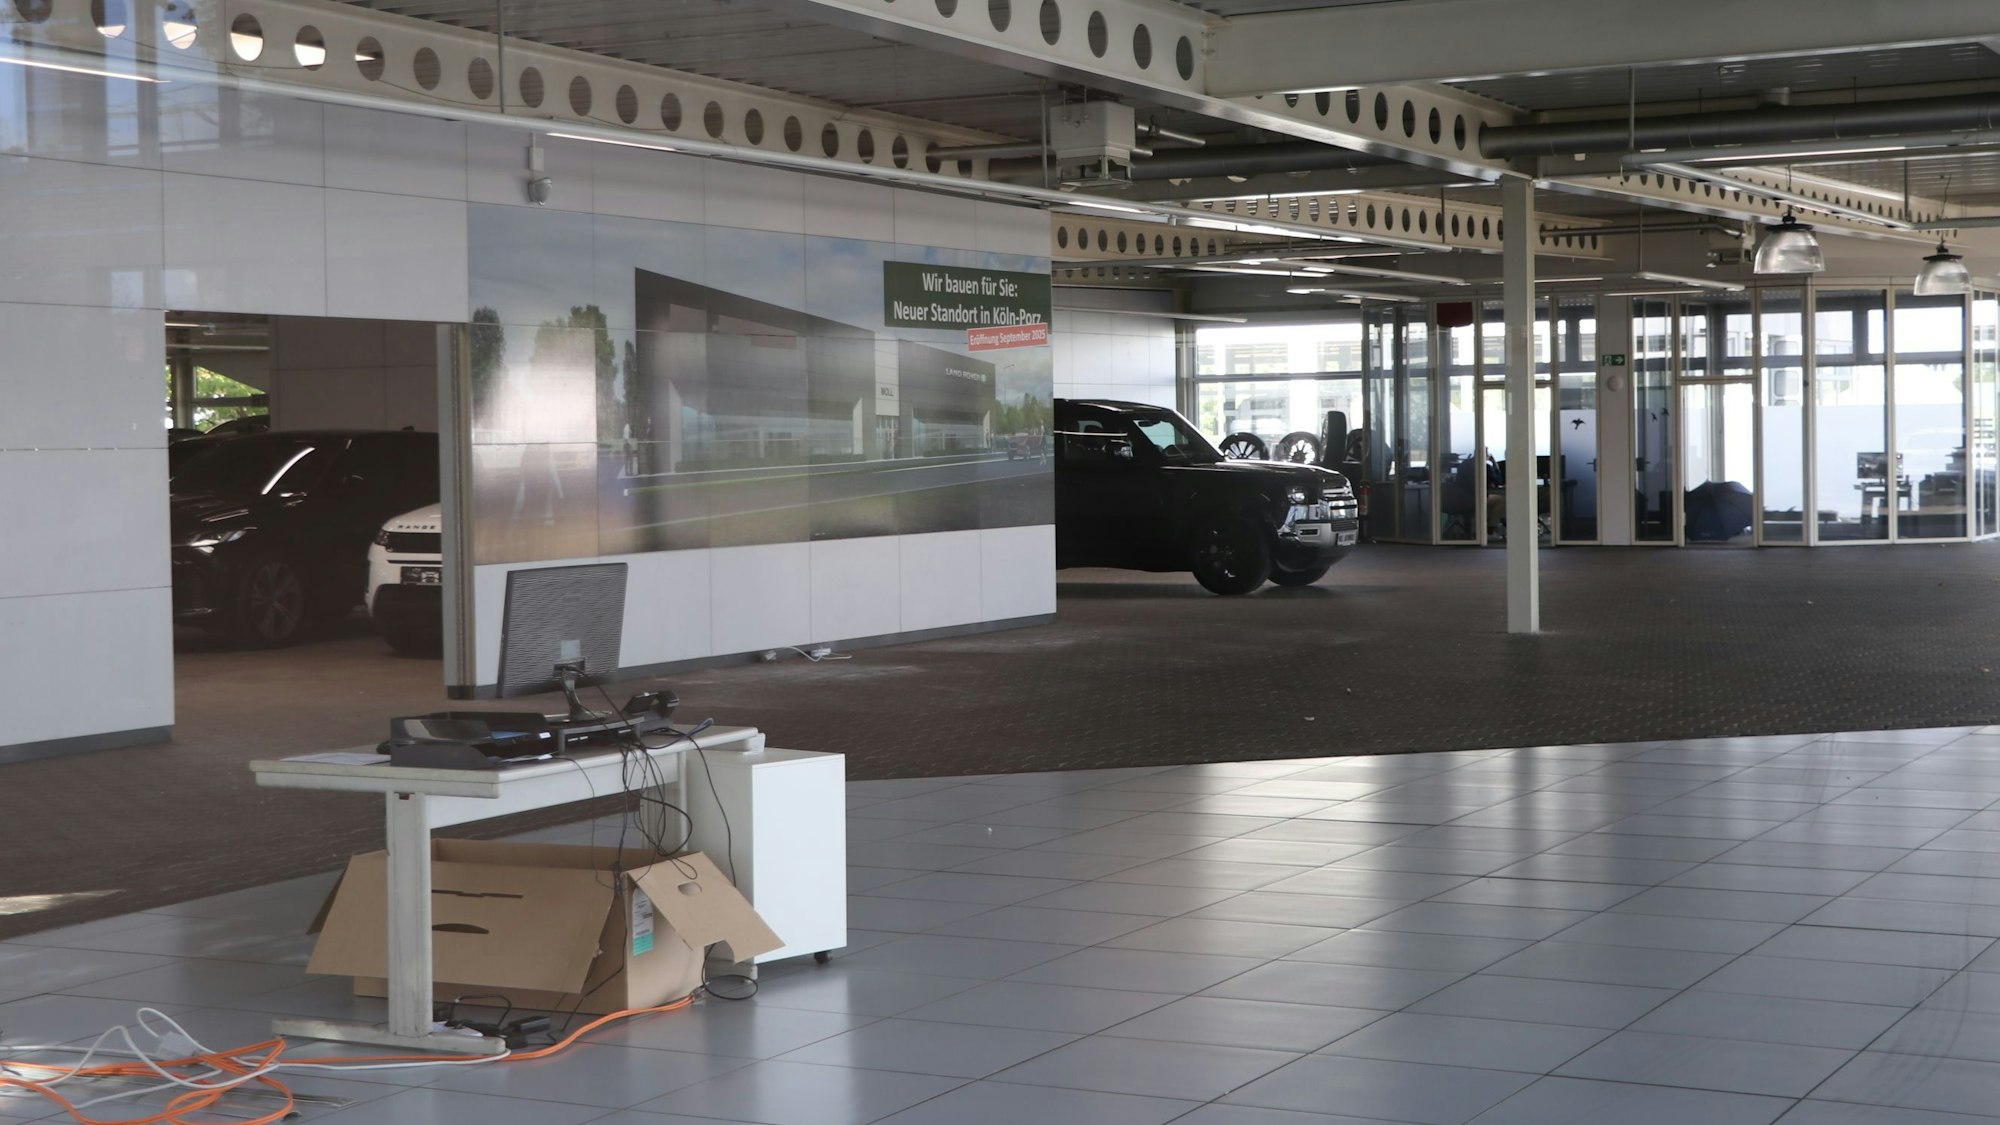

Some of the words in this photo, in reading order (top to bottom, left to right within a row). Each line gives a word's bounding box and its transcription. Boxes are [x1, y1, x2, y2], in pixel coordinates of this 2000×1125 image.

[922, 272, 943, 292] Wir
[945, 274, 979, 295] bauen
[981, 276, 997, 296] für
[999, 278, 1018, 298] Sie:
[893, 301, 928, 321] Neuer
[931, 303, 978, 323] Standort
[980, 305, 991, 324] in
[993, 306, 1041, 326] Köln-Porz
[970, 333, 999, 346] Eröffnung
[999, 331, 1031, 345] September
[1031, 328, 1046, 341] 2025
